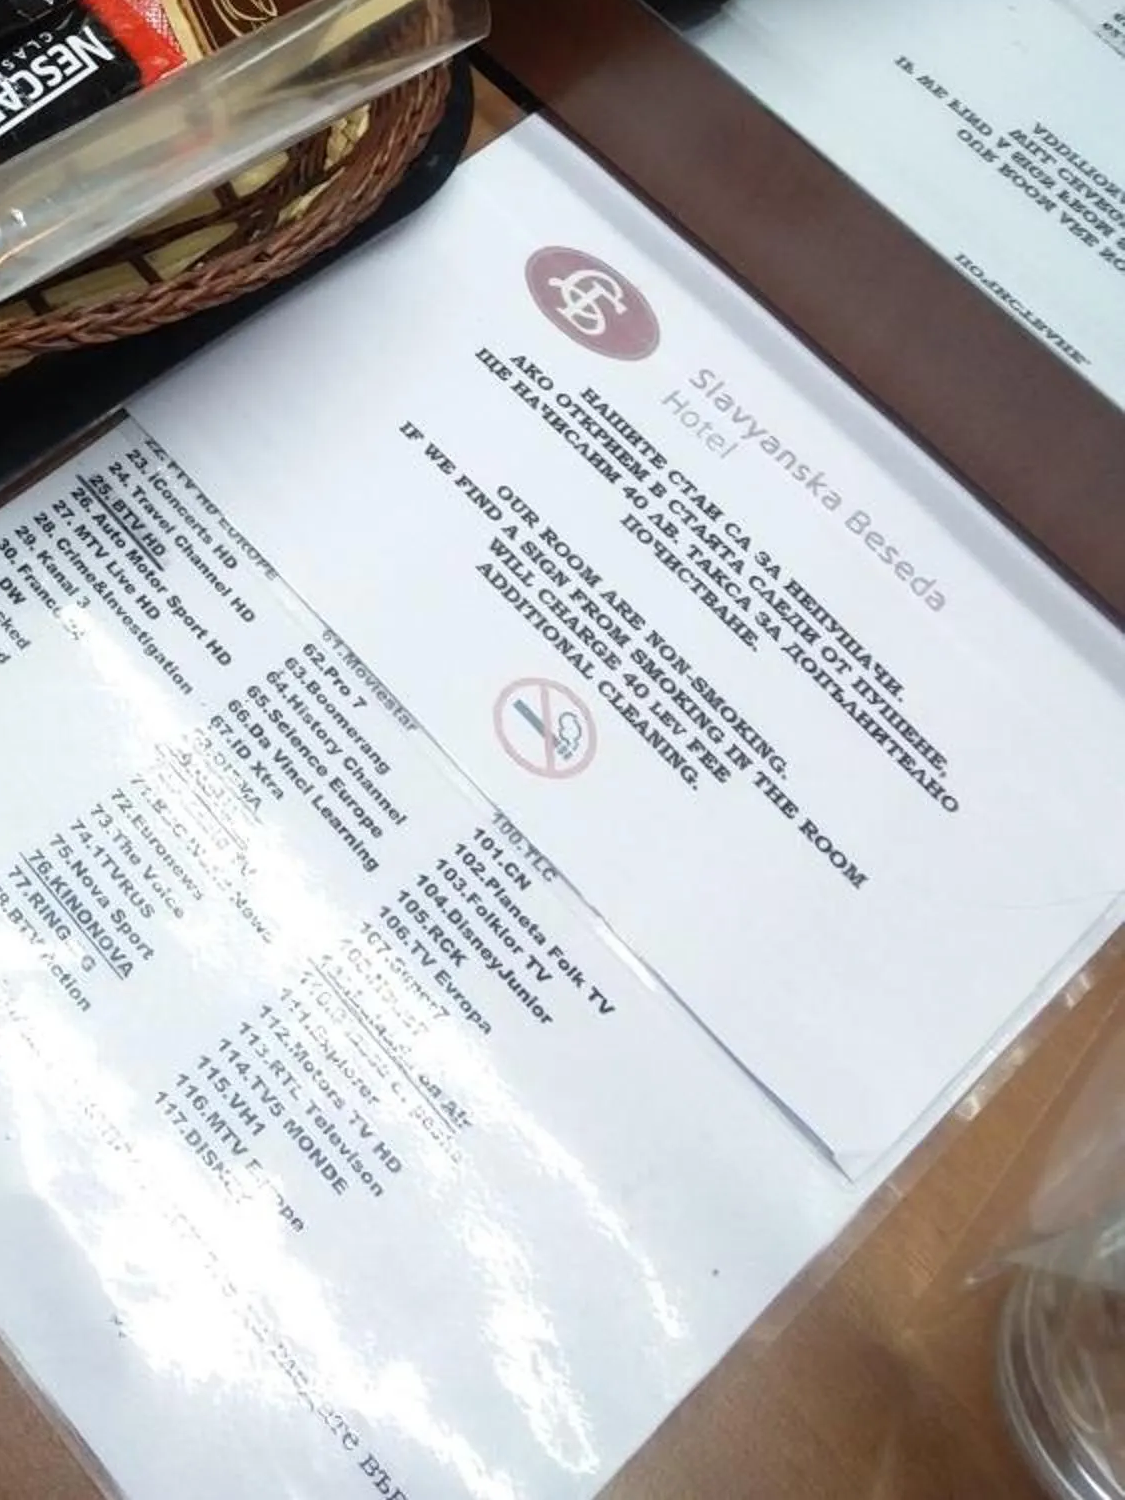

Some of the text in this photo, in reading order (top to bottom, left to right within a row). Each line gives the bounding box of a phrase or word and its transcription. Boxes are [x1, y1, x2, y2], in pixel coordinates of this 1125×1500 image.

[660, 389, 739, 460] Hotel
[689, 369, 948, 612] Slavyanska Beseda
[13, 524, 39, 552] 29.
[35, 549, 81, 597] Kanal
[76, 595, 92, 609] 3
[51, 499, 162, 621] 27. MTV Live HD
[69, 485, 233, 667] 26. Auto Motor Sport HD
[89, 474, 167, 557] 25. BTV HD
[107, 461, 133, 488] 24.
[172, 533, 233, 598] Channel
[229, 596, 256, 623] HD
[125, 448, 239, 570] 23. iConcerts HD
[509, 353, 951, 778] АКО ОТКРИЕМ В СТАЯТА СЛЕДИ ОТ ПУШЕНЕ,
[579, 387, 908, 703] НАШИТЕ СТАИ СА ЗА НЕПУШАЧИ.
[32, 511, 195, 696] 28. Crime&Investigation
[474, 347, 961, 813] ЩЕ НАЧИСЛИМ 40 ЛВ. ТАКСА ЗА ДОПЪЛНИТЕЛНО
[495, 484, 791, 781] OUR ROOM ARE NON-SMOKING.
[619, 513, 762, 653] ПОЧИСТВАНЕ.
[283, 656, 392, 776] 63.Boomerang
[301, 642, 368, 710] 62.Pro 7
[398, 420, 870, 890] IF WE FIND A SIGN FROM SMOKING IN THE ROOM
[475, 561, 702, 791] ADDITIONAL CLEANING.
[486, 536, 733, 784] WILL CHARGE 40 LEV FEE
[207, 713, 253, 762] 67.ID
[248, 759, 285, 801] Xtra
[226, 698, 273, 750] 66.Da
[271, 747, 316, 796] Vinci
[309, 793, 381, 873] Learning
[244, 684, 385, 840] 65.Science Europe
[263, 669, 408, 826] 64.History Channel
[48, 832, 156, 961] 75.Nova Sport
[89, 802, 144, 866] 73.The
[472, 826, 532, 892] 101.CN
[27, 848, 135, 979] 76.KINONOVA
[377, 904, 438, 969] 106.TV
[431, 968, 493, 1036] Evropa
[396, 888, 469, 969] 105.RCK
[414, 873, 555, 1026] 104.DisneyJunior
[434, 857, 554, 984] 103.Folklor TV
[453, 841, 616, 1016] 102.Planeta Folk TV
[174, 1072, 250, 1158] 116.MTV
[195, 1054, 268, 1137] 115.VH1
[216, 1037, 287, 1118] 114.TV5
[281, 1117, 350, 1196] MONDE
[346, 1108, 376, 1140] TV
[370, 1140, 404, 1175] HD
